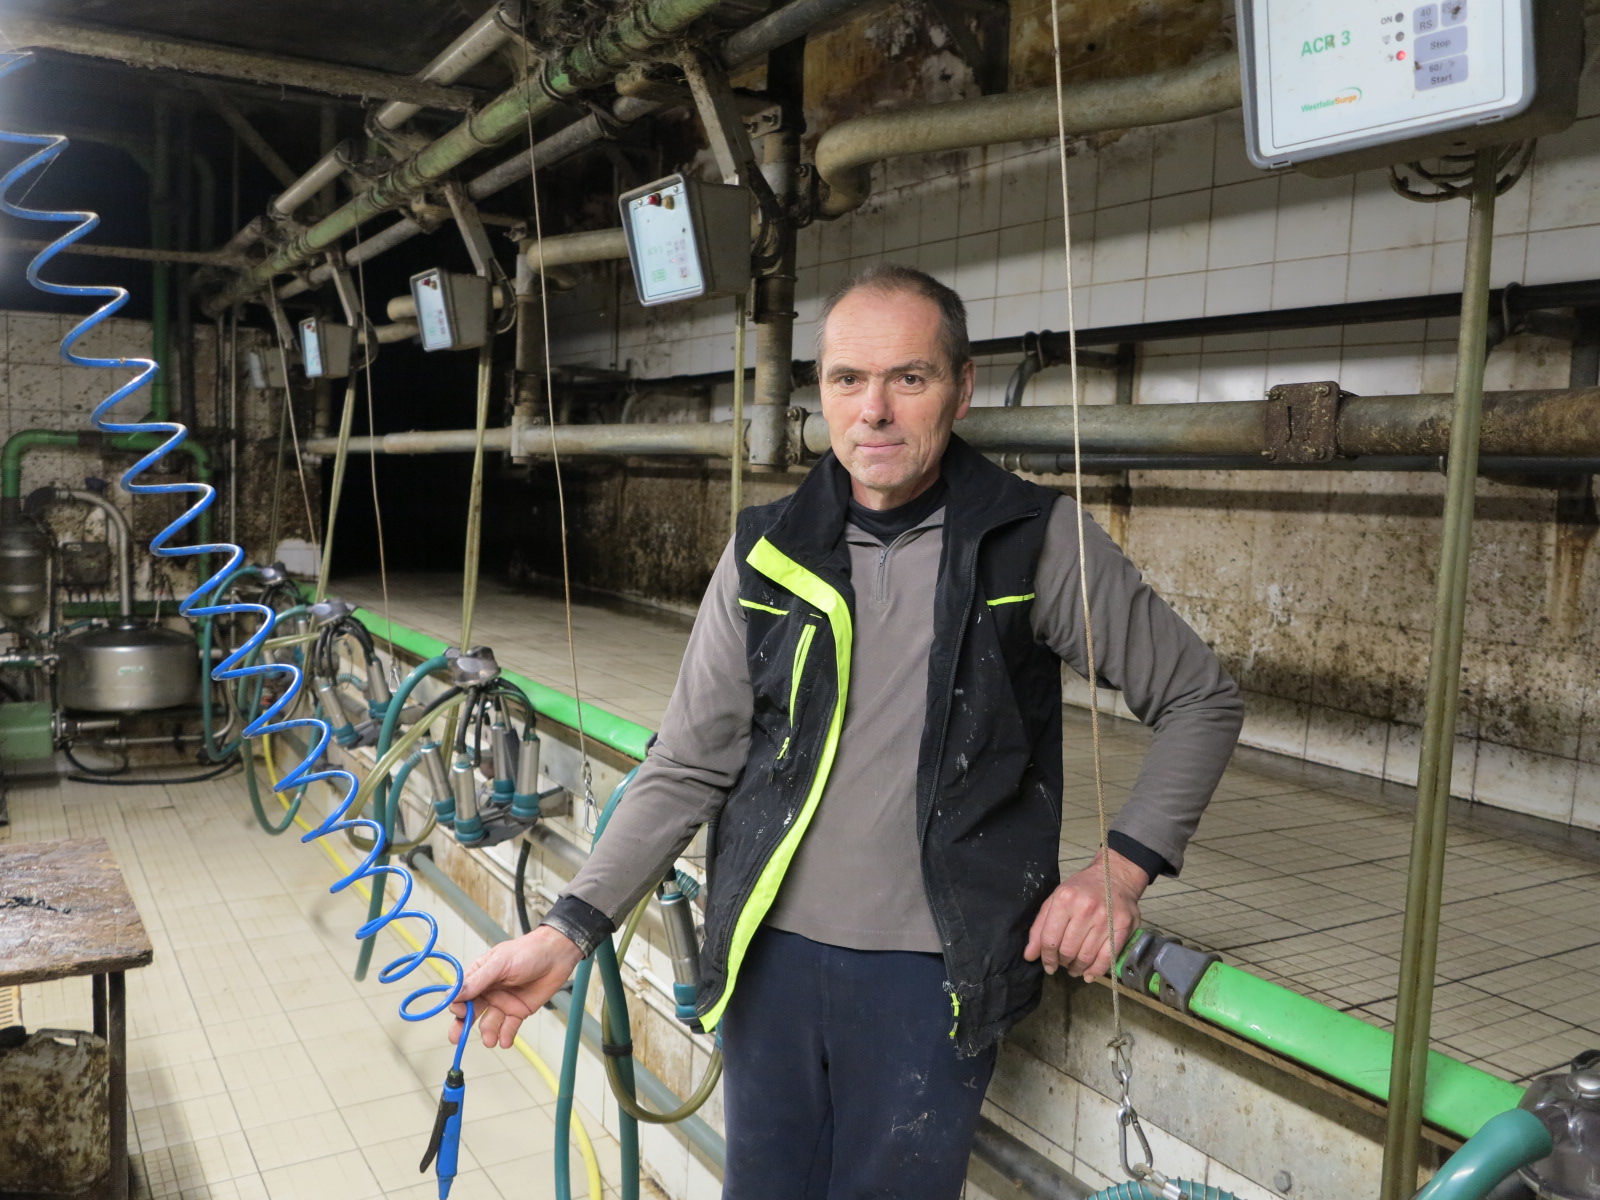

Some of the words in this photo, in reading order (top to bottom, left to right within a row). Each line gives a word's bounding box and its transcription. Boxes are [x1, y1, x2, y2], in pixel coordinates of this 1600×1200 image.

[1420, 8, 1432, 17] 40
[1380, 15, 1393, 25] ON
[1420, 20, 1433, 31] RS
[1301, 33, 1336, 57] ACR
[1341, 30, 1351, 46] 3
[1430, 39, 1451, 50] Stop
[1430, 73, 1452, 85] Start
